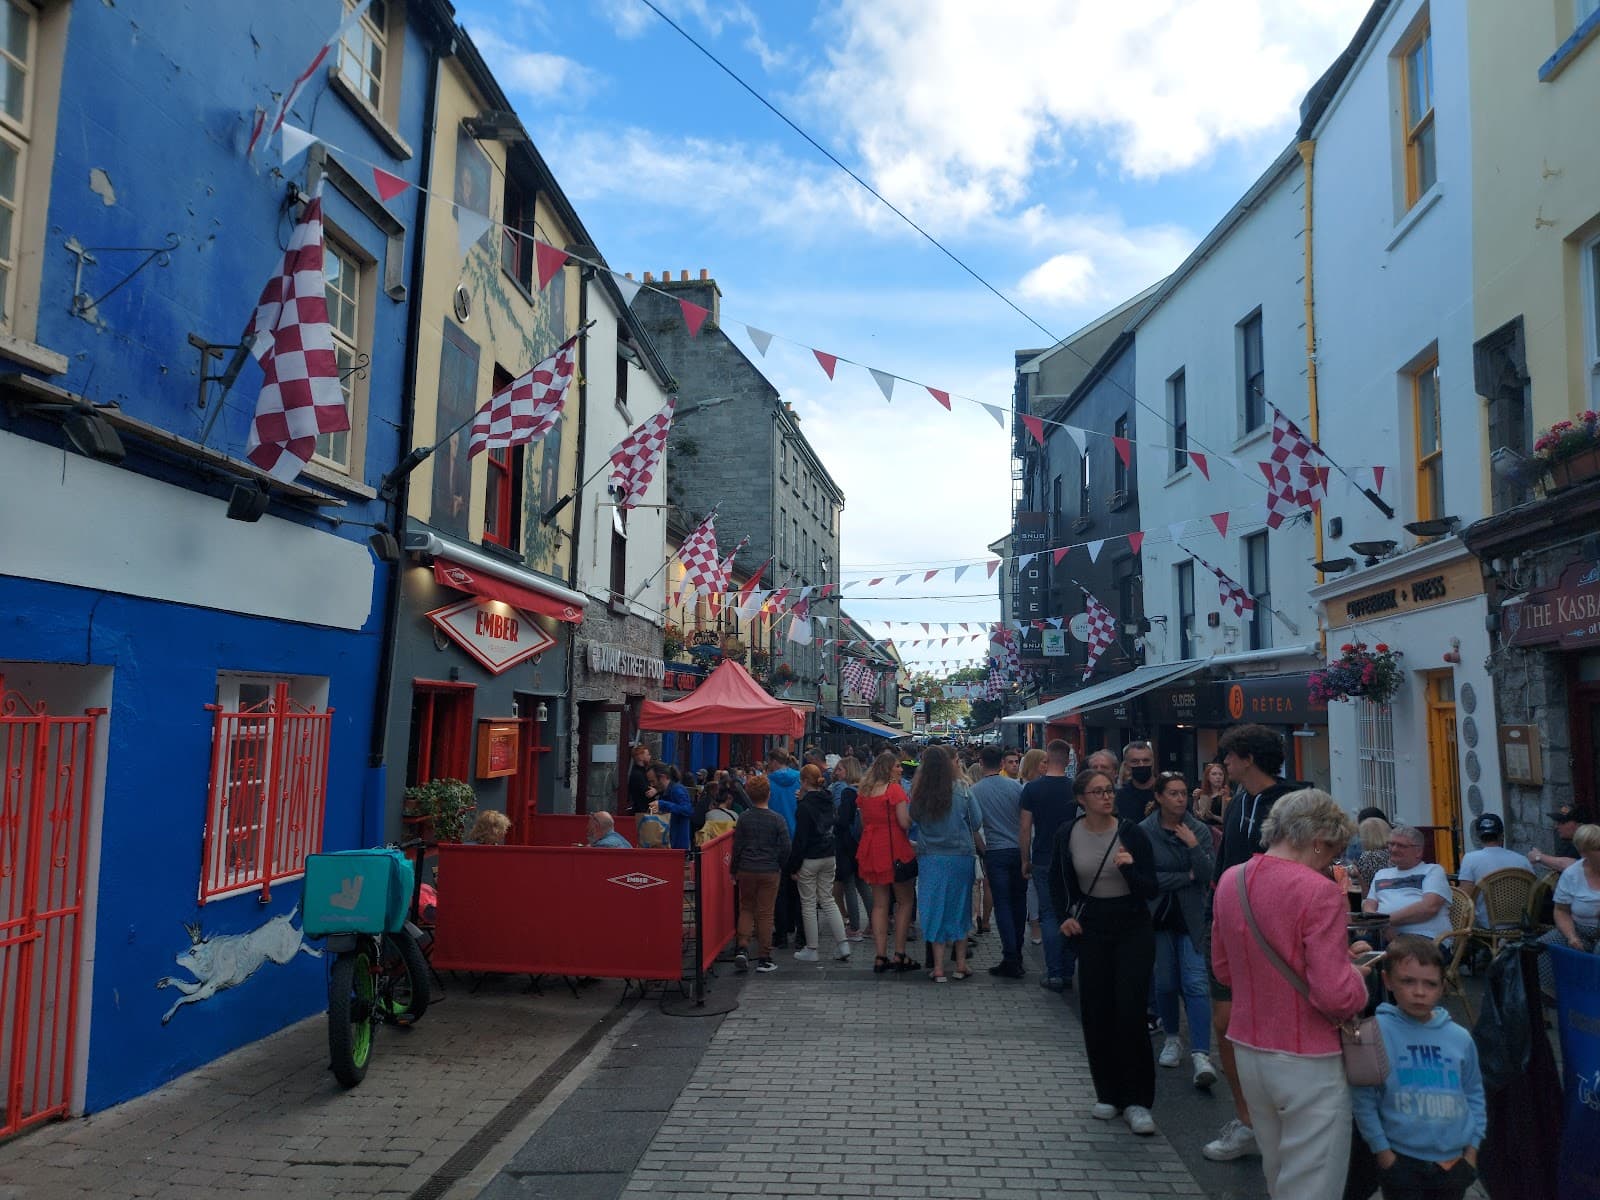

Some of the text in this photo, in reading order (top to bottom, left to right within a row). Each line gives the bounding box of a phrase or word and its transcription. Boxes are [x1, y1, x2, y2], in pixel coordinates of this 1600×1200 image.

[1412, 576, 1447, 603] PRESS
[474, 610, 520, 643] EMBER
[1526, 604, 1552, 629] THE
[621, 651, 647, 678] STREET
[648, 656, 665, 680] FOOD
[1406, 1044, 1444, 1069] THE
[1394, 1092, 1413, 1114] IS
